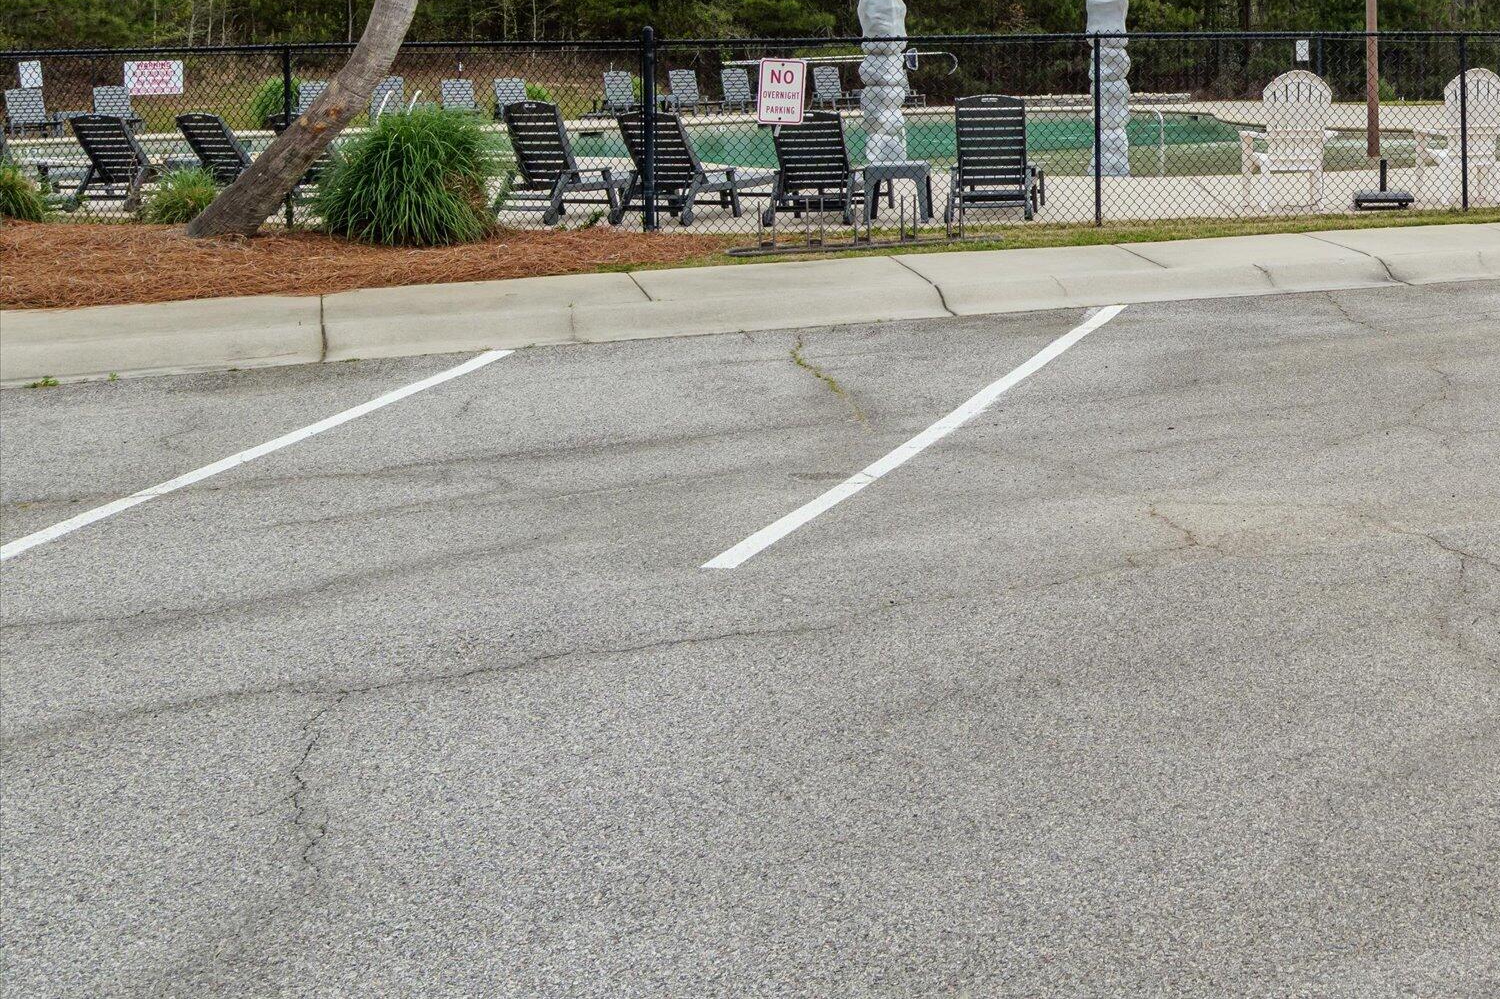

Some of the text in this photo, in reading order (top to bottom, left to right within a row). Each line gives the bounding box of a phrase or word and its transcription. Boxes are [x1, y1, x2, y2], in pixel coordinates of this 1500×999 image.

[770, 69, 794, 84] NO
[762, 90, 800, 100] OVERNIGHT
[766, 106, 795, 114] PARKING
